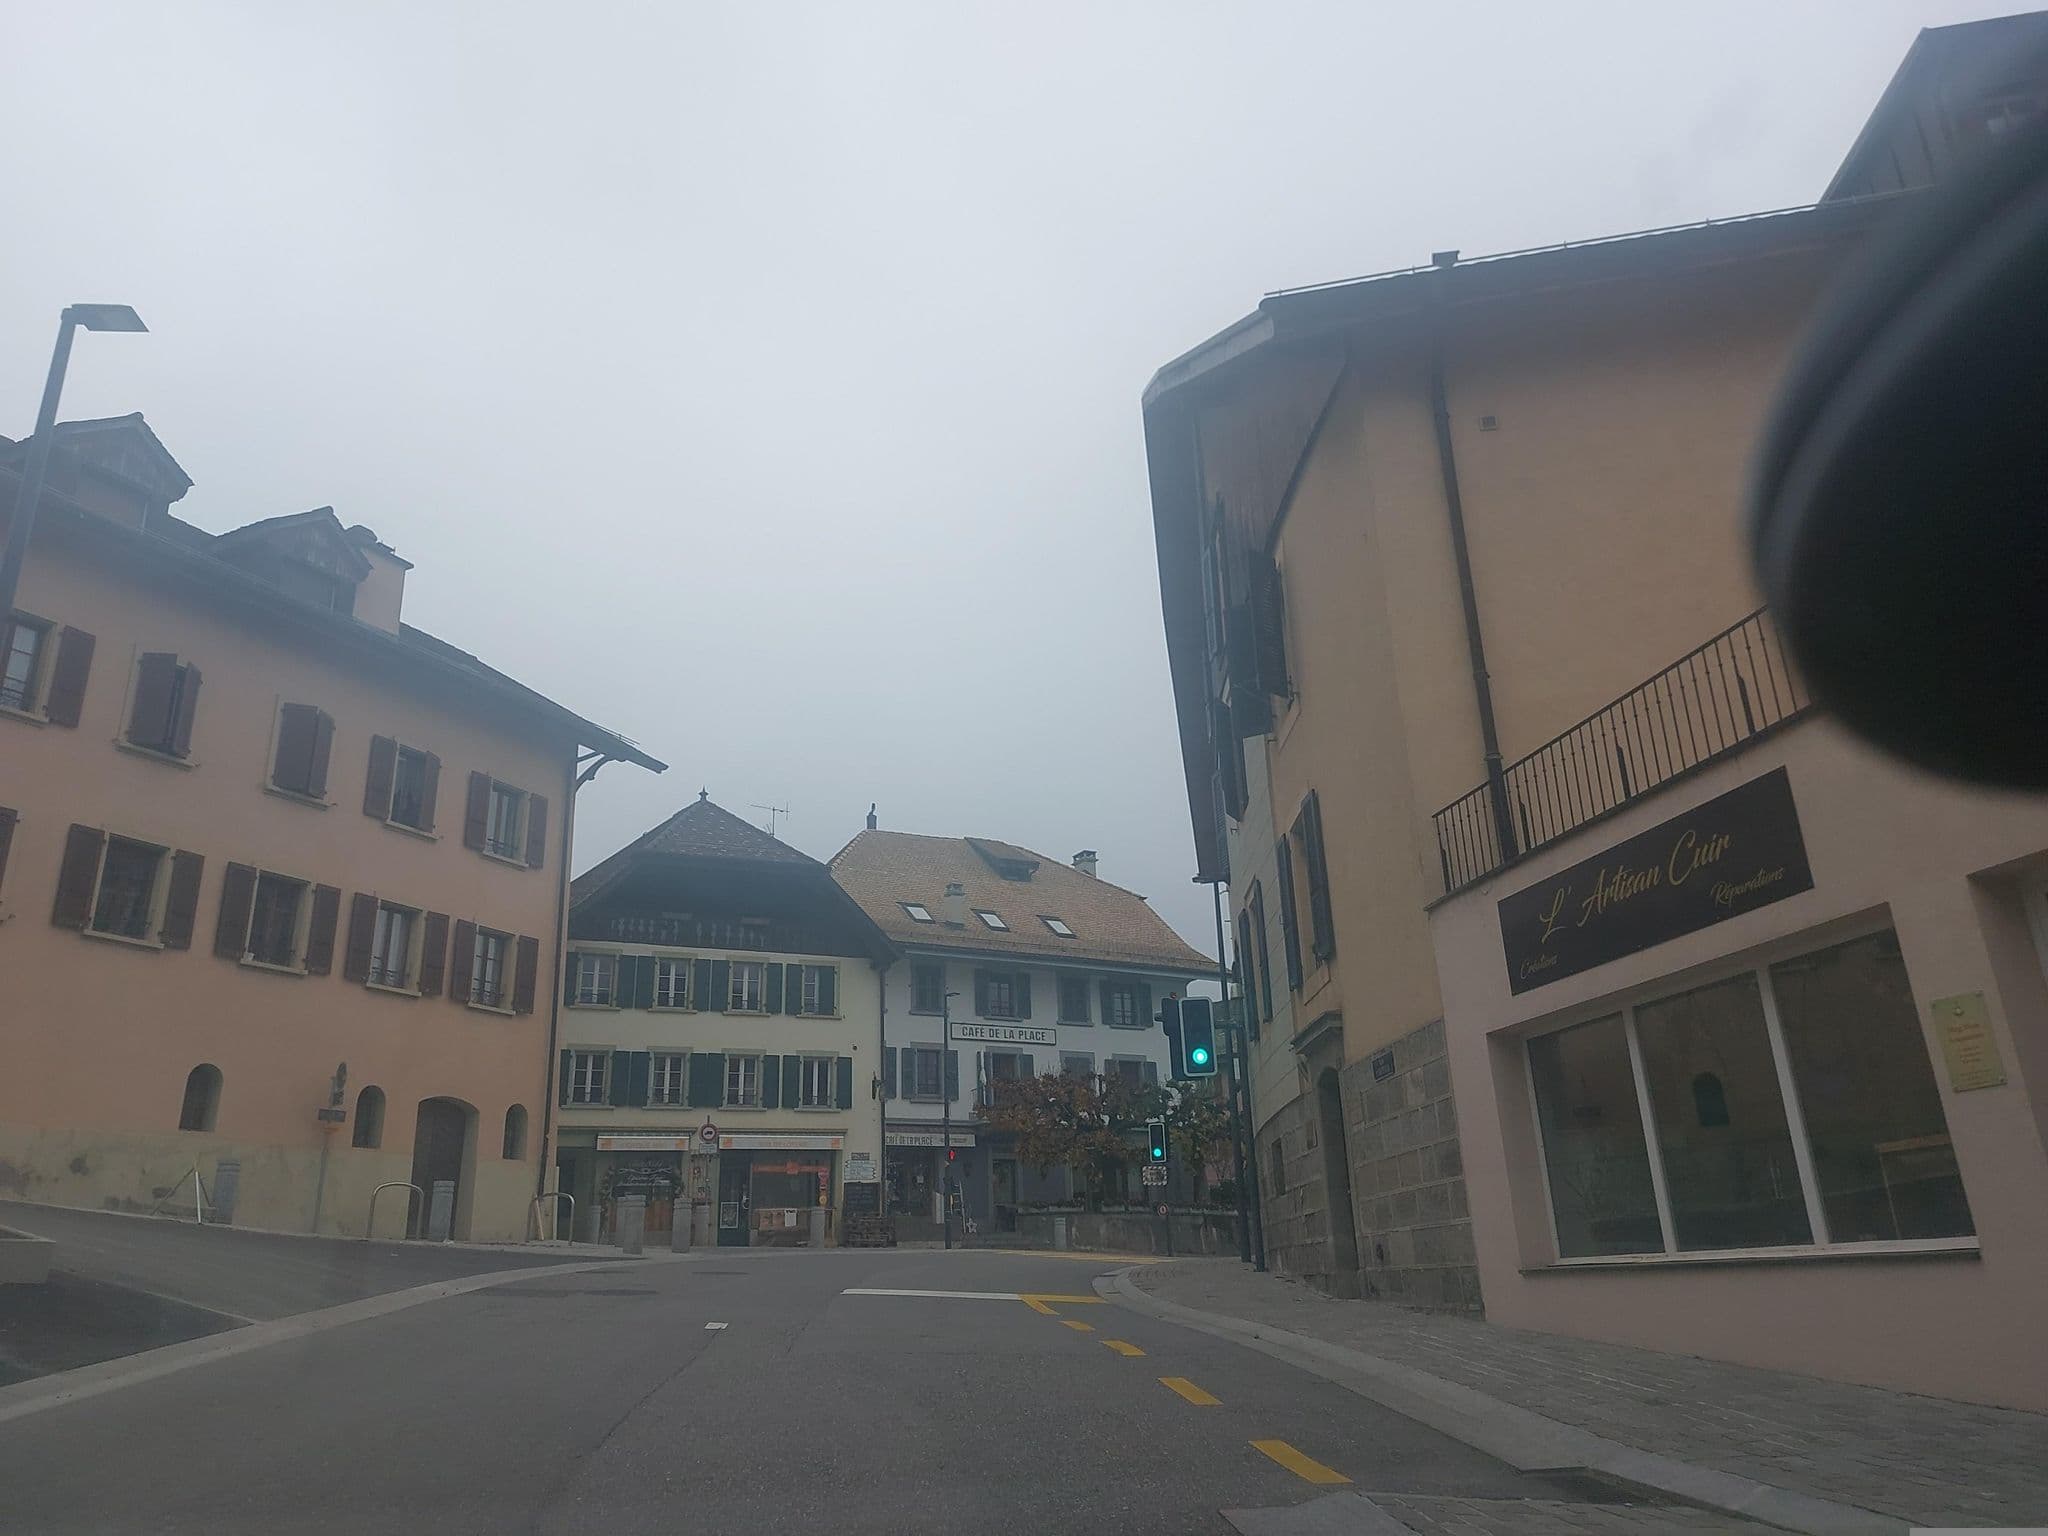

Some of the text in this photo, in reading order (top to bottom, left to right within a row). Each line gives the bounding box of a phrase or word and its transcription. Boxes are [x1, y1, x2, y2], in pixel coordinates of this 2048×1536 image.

[1576, 863, 1661, 928] Artisan
[1668, 830, 1734, 886] Cuir
[989, 1028, 1000, 1038] DE
[1004, 1029, 1015, 1039] LA
[1018, 1030, 1046, 1041] PLACE
